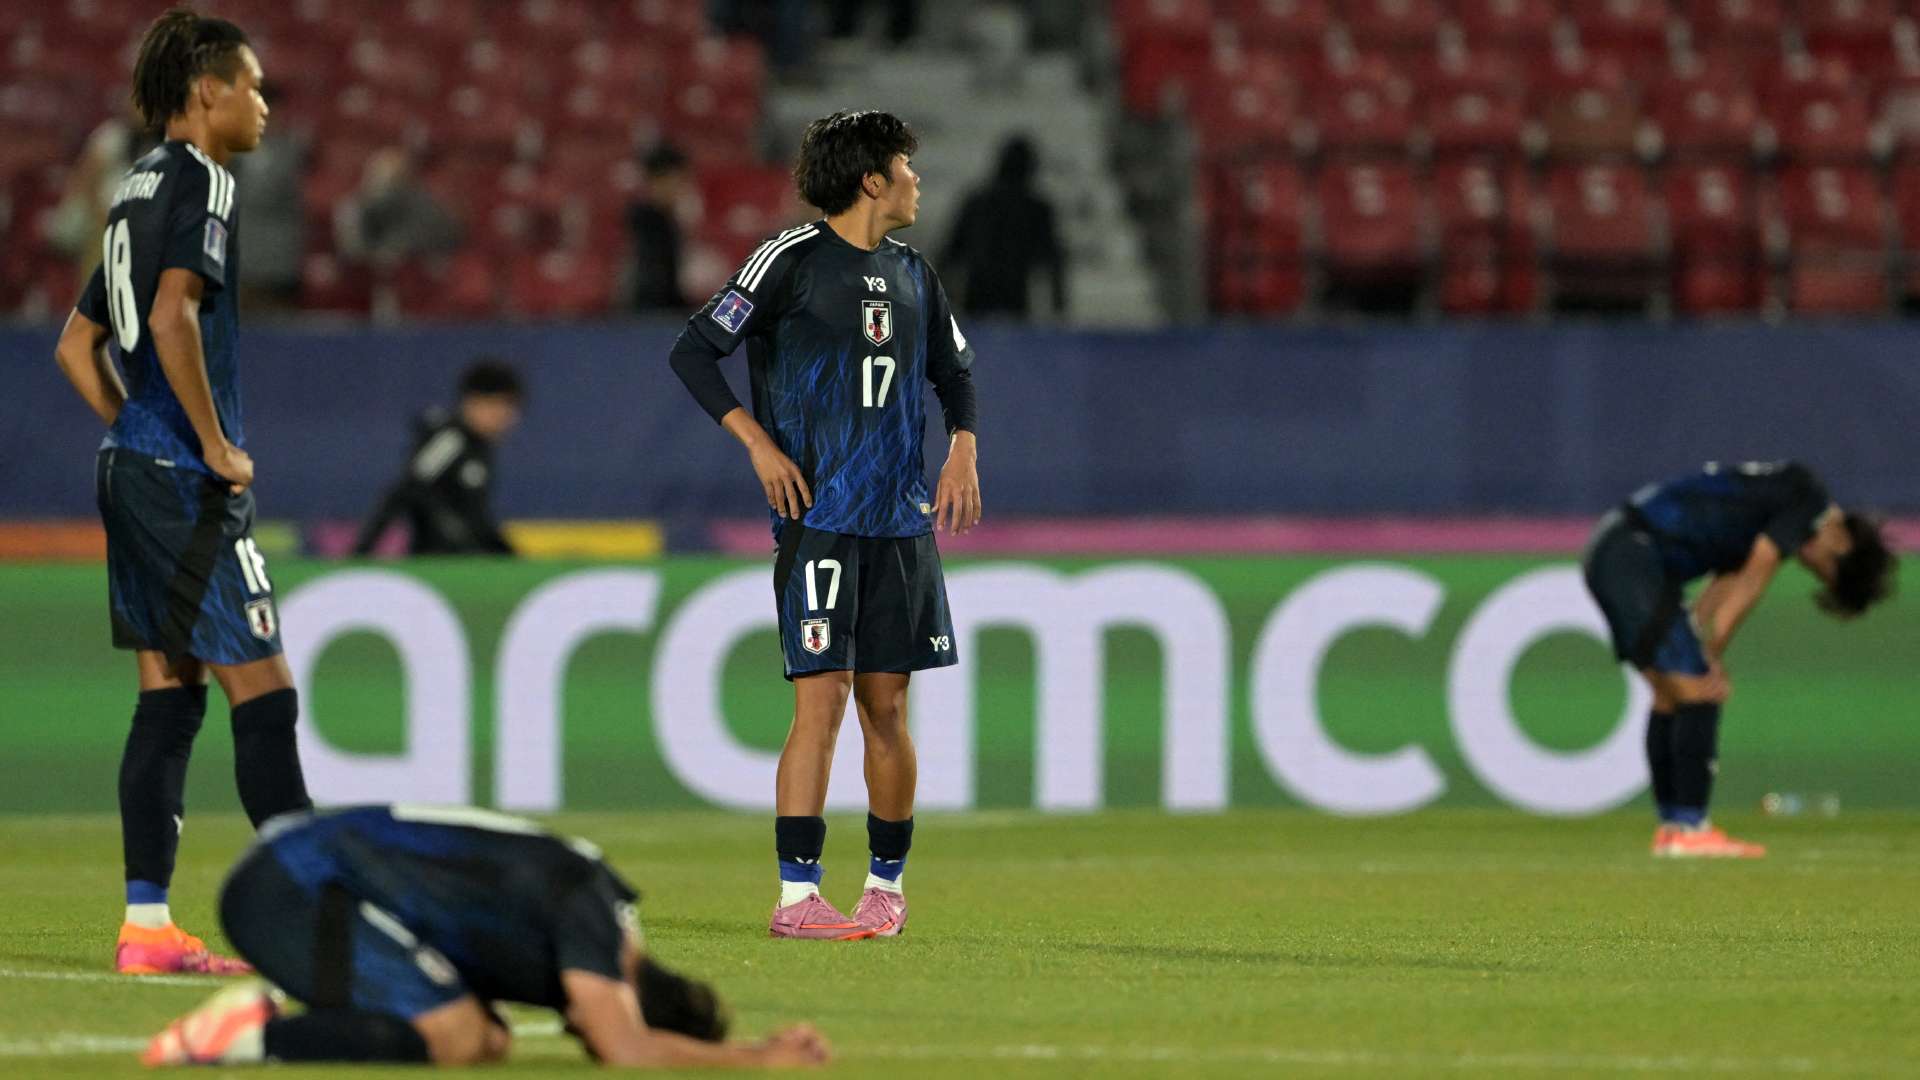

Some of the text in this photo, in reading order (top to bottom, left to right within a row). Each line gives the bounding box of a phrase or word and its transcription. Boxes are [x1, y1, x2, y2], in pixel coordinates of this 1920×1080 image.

[103, 218, 140, 353] 18
[862, 355, 896, 408] 17
[805, 559, 842, 611] 17
[279, 565, 1653, 816] aramco
